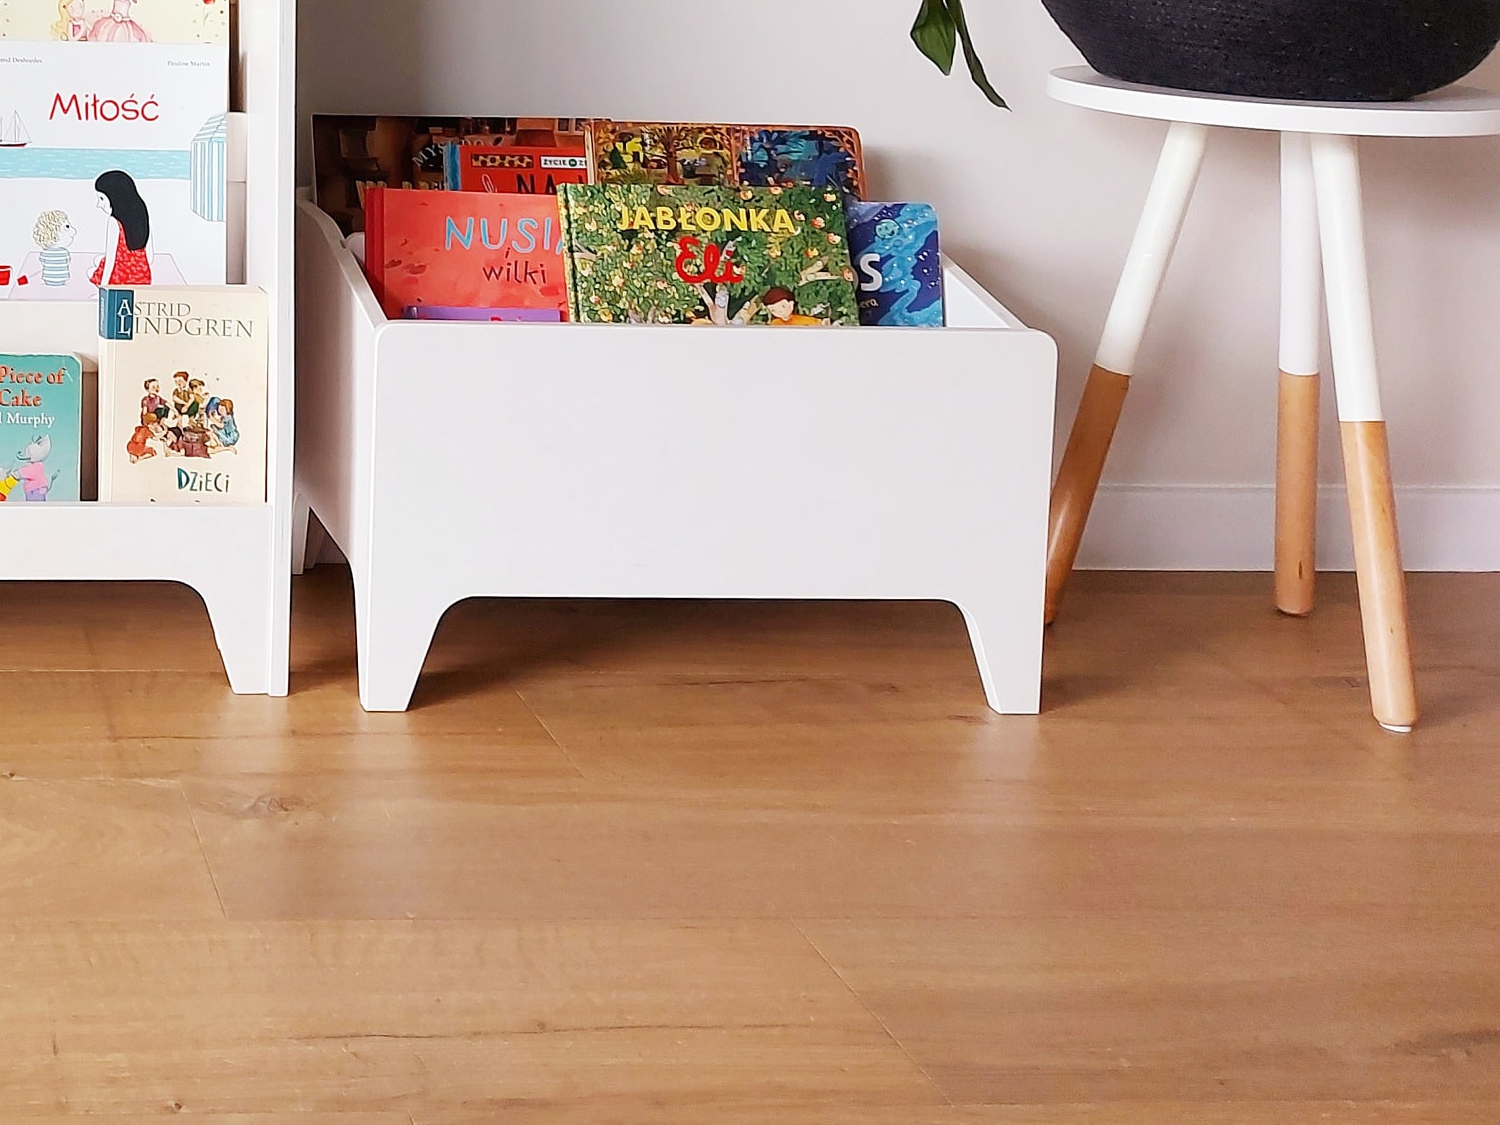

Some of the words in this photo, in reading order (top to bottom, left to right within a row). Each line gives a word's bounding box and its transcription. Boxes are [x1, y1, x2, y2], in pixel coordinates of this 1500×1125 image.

[49, 92, 160, 122] Miłość
[617, 205, 796, 235] JABŁONKA
[444, 216, 564, 255] NUSI
[505, 247, 511, 259] i
[674, 235, 745, 285] Eli
[482, 259, 547, 285] wilki
[117, 298, 191, 317] ASTRID
[117, 315, 253, 338] LINDGREN
[46, 366, 67, 385] of
[6, 412, 55, 428] Murphy
